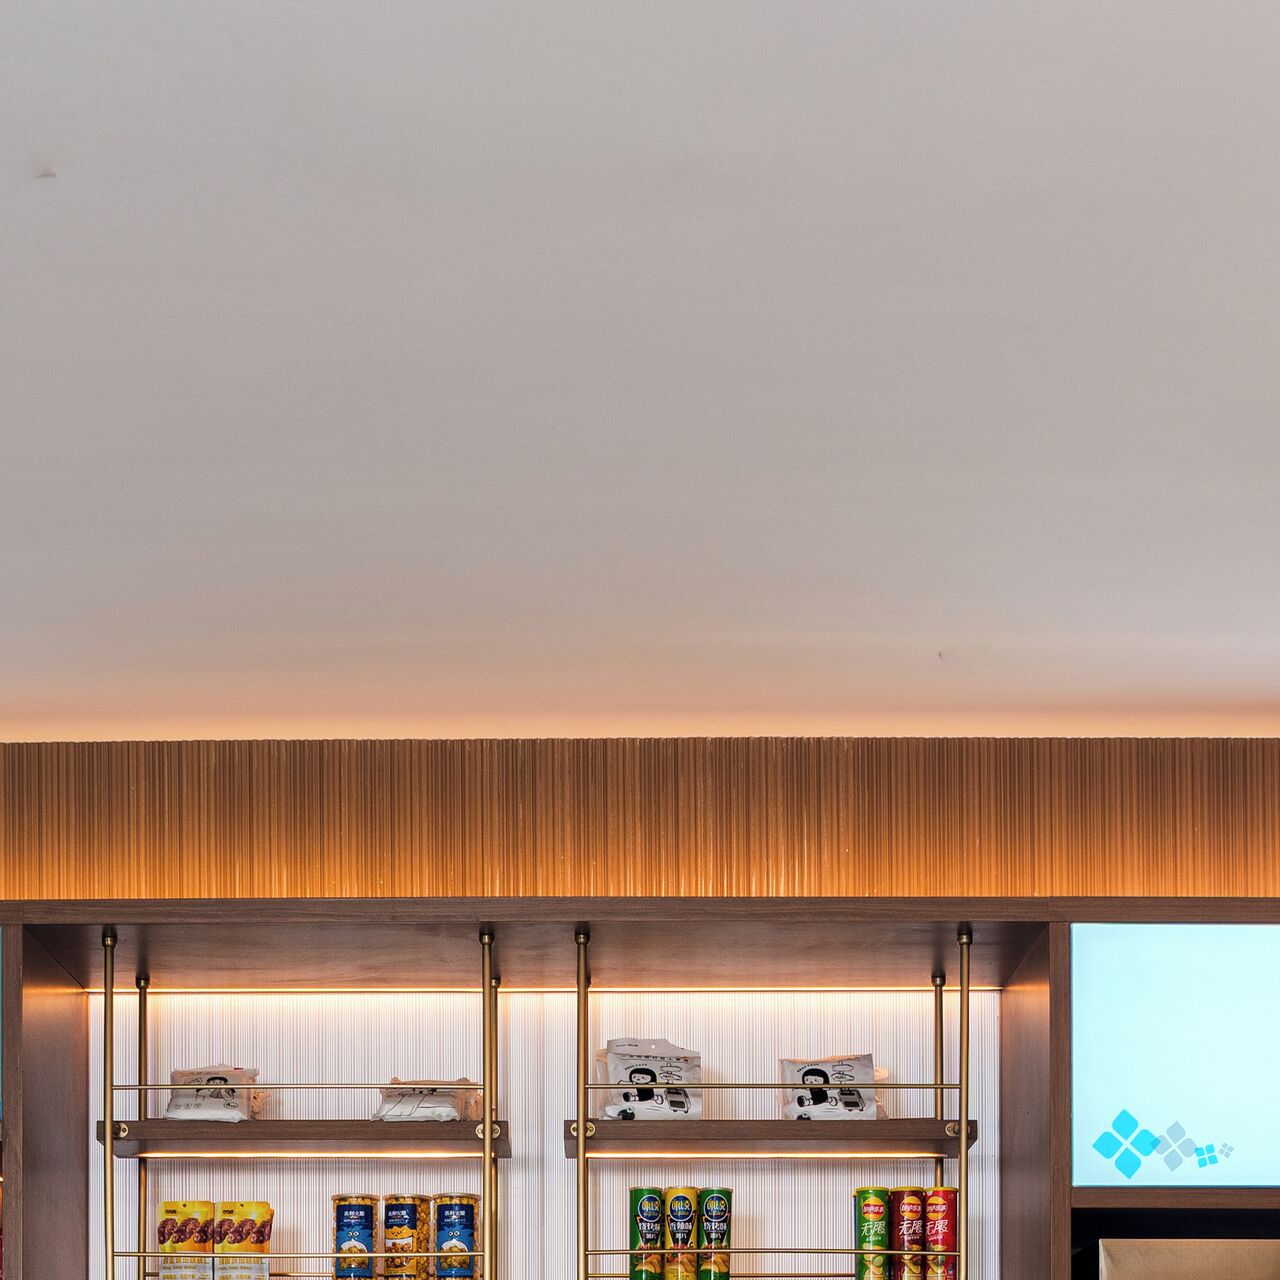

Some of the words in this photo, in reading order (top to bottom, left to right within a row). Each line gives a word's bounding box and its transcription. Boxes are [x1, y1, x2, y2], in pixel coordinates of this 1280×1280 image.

[861, 1221, 885, 1237] 无限
[899, 1220, 922, 1235] 无限
[926, 1220, 948, 1235] 无限
